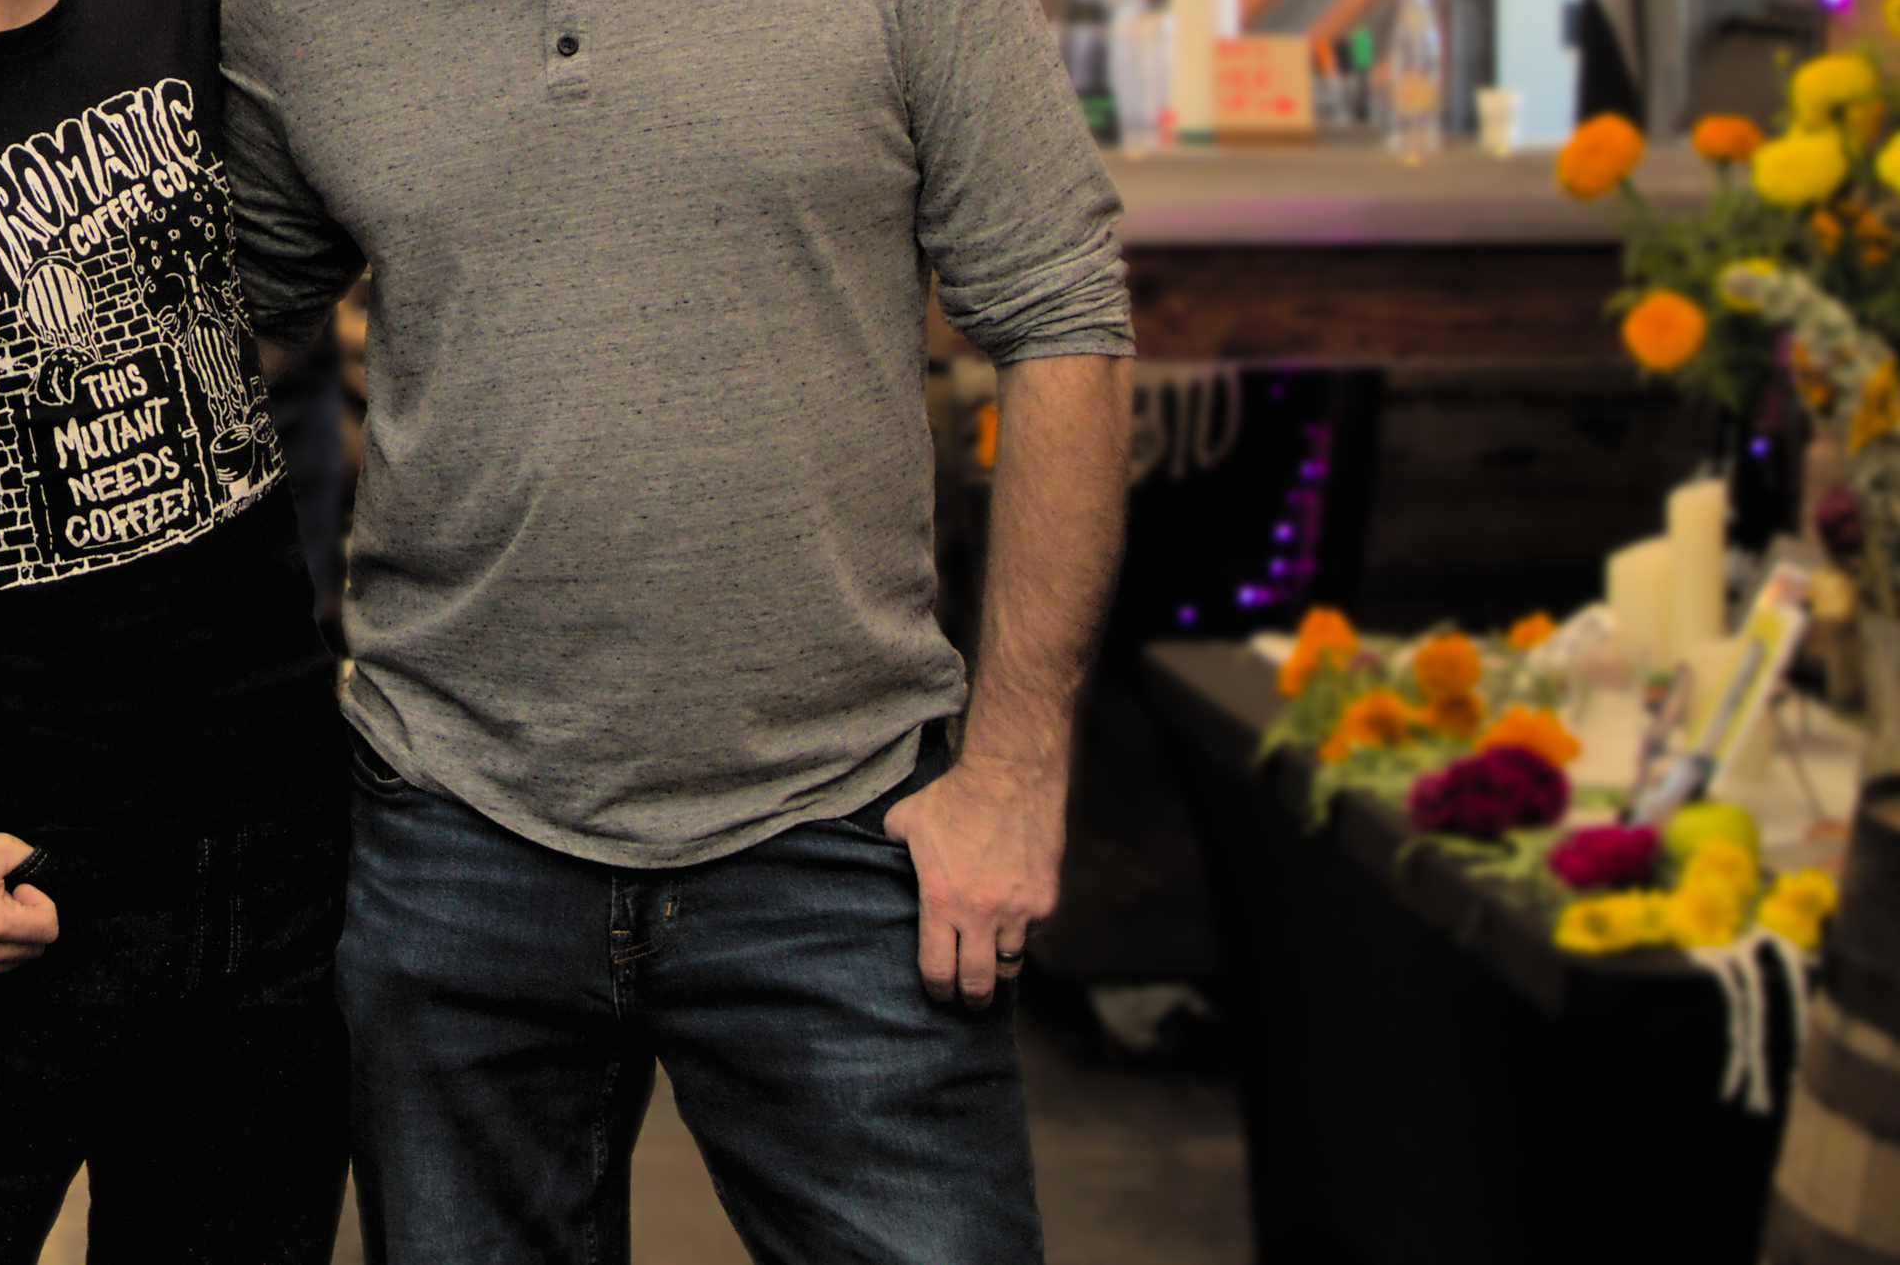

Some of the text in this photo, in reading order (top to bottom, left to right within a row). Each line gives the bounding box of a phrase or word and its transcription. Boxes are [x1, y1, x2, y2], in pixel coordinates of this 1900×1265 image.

[69, 162, 195, 255] COFFEE CO.
[81, 363, 148, 409] THIS
[53, 396, 169, 469] MUTANT
[67, 446, 180, 506] NEEDS
[65, 478, 190, 547] COFFEE!
